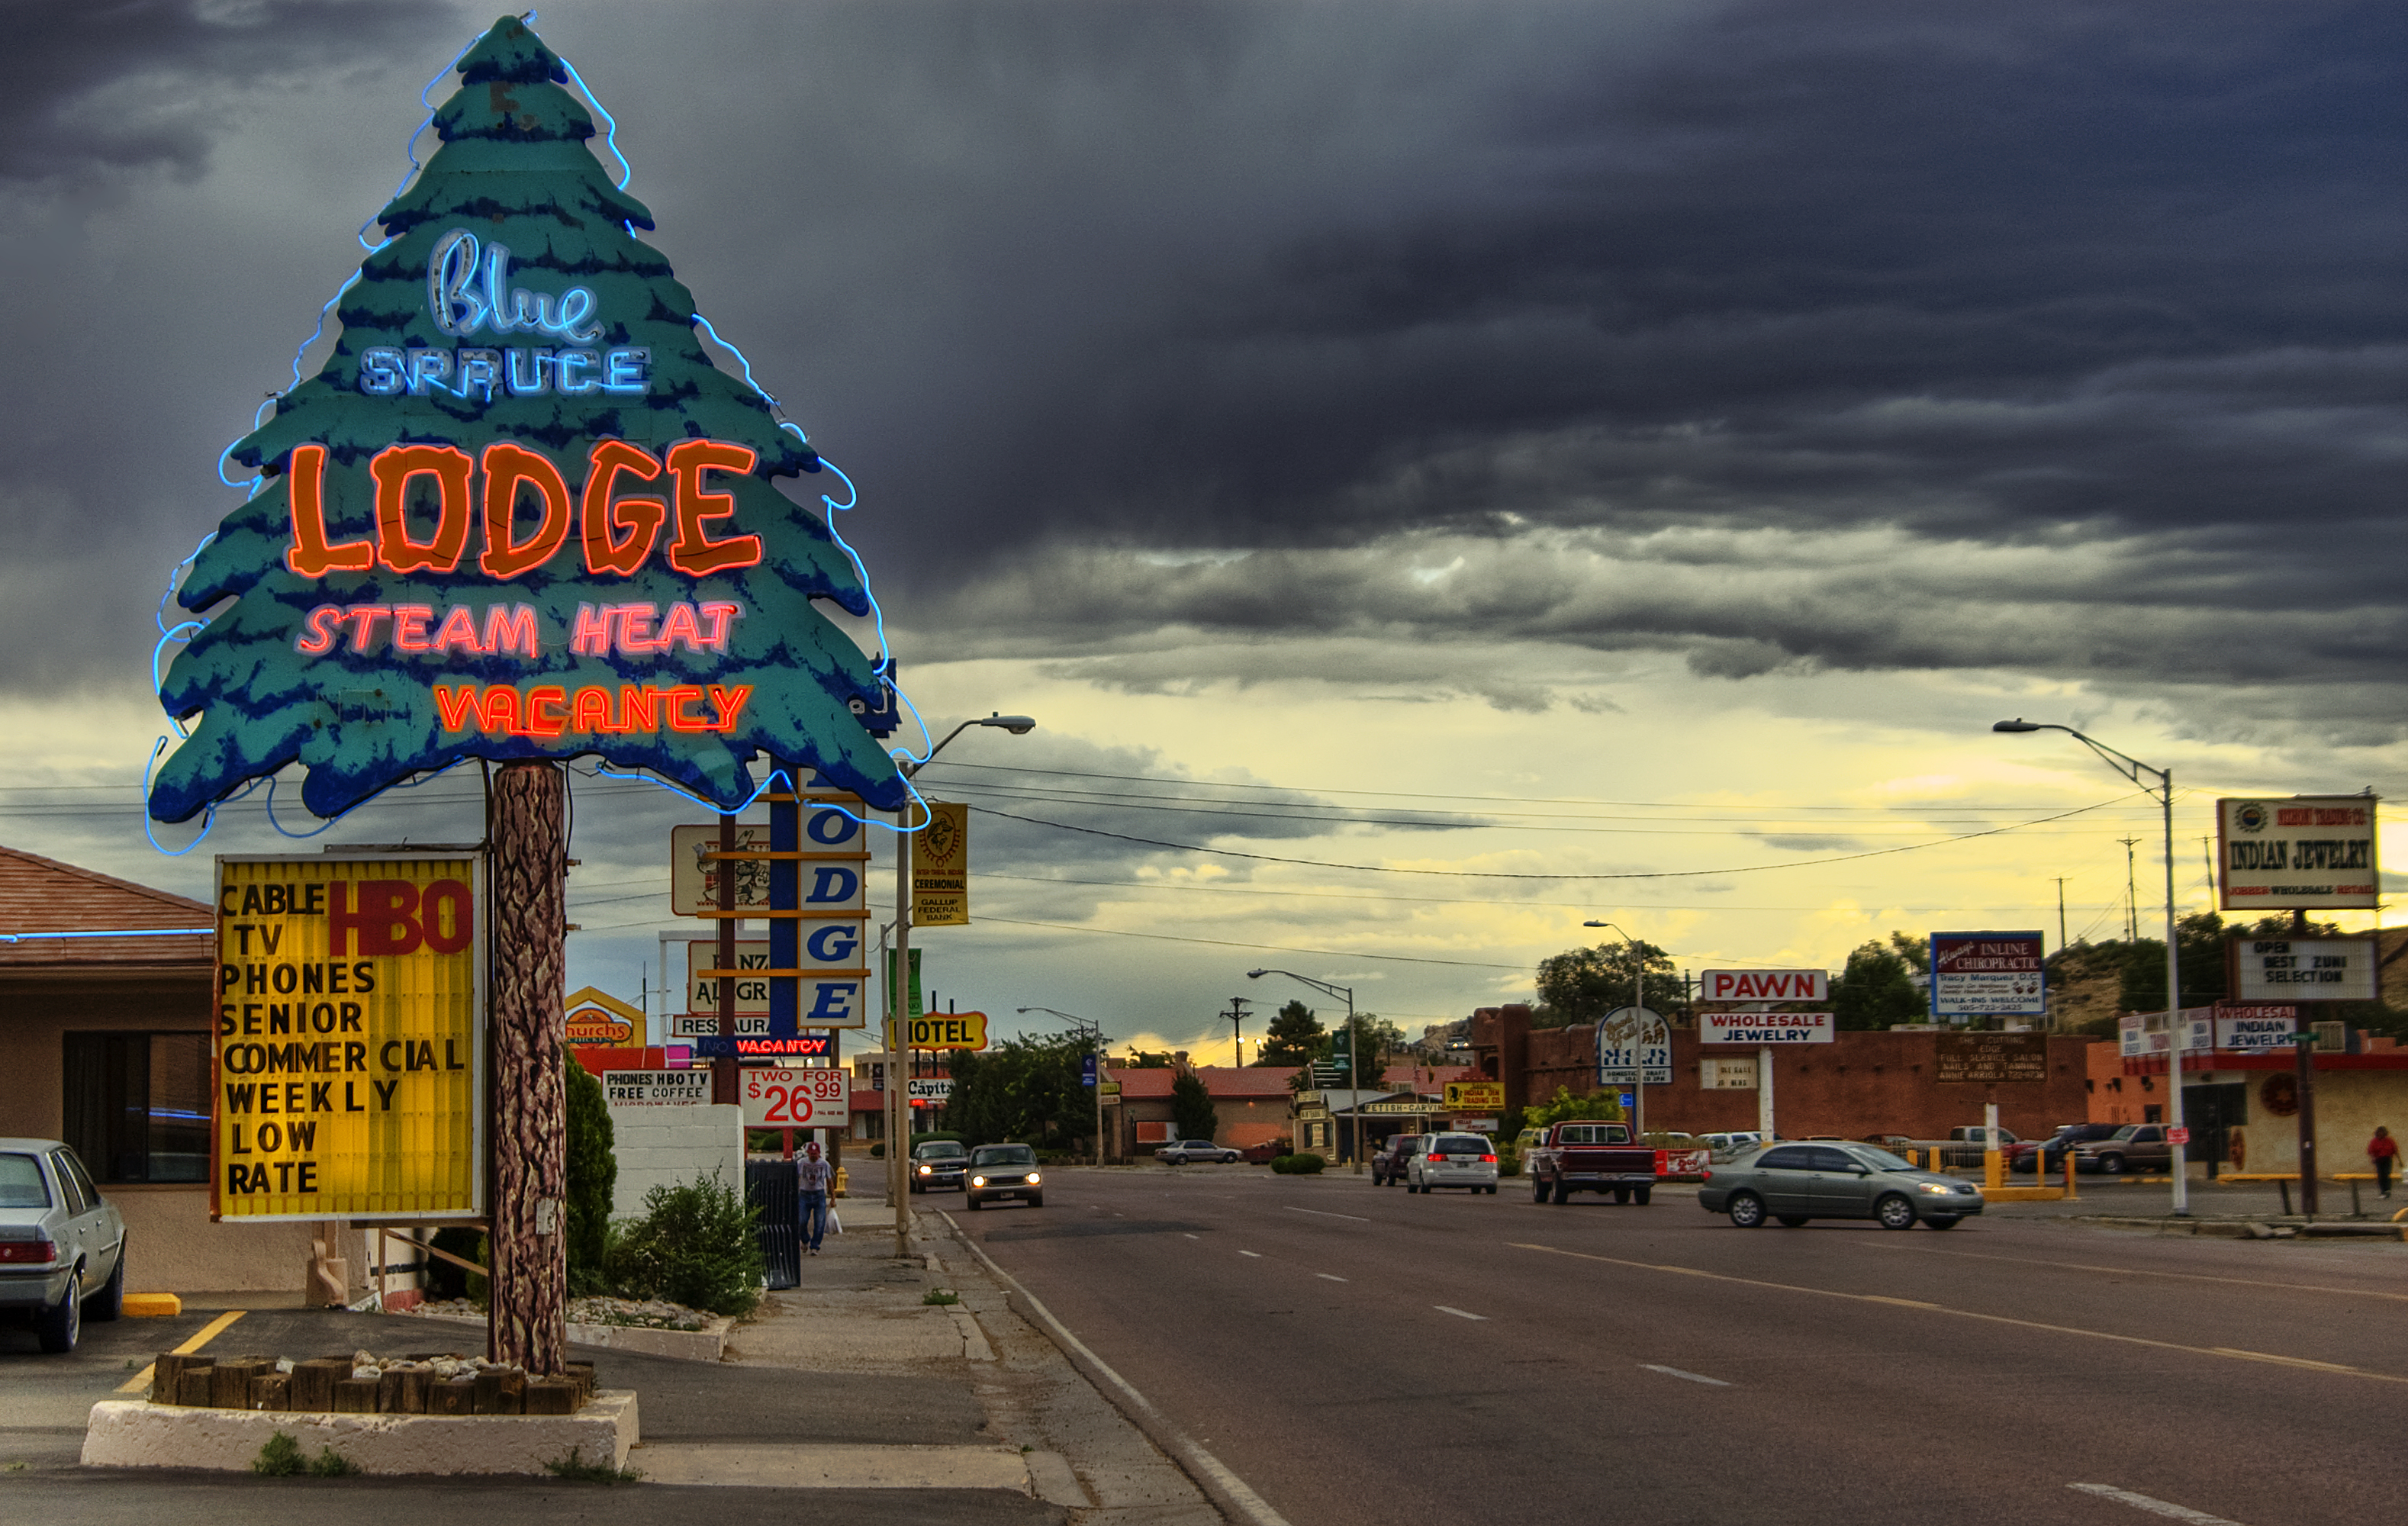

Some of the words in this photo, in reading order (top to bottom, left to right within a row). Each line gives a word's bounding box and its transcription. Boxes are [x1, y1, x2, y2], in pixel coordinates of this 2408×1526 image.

[429, 229, 605, 345] Blue
[360, 347, 651, 398] SPRUCE
[285, 439, 763, 578] LODGE
[295, 604, 542, 657] STEAM
[571, 602, 745, 655] HEAT
[433, 684, 754, 734] VACANCY
[2229, 840, 2287, 869] INDIAN
[2292, 840, 2369, 869] JEWELRY
[915, 879, 964, 890] CEREMONIAL
[222, 884, 324, 916] CABLE
[330, 879, 474, 957] HBO
[233, 924, 283, 955] TV
[1979, 942, 2029, 955] INLINE
[2253, 941, 2290, 954] OPEN
[1956, 957, 2039, 970] CHIROPRACTIC
[2264, 955, 2297, 968] BEST
[2313, 955, 2347, 968] ZUNI
[221, 961, 375, 995] PHONES
[1939, 974, 1965, 982] Tracy
[2265, 970, 2343, 983] SELECTION
[1716, 974, 1814, 998] PAWN
[221, 1002, 362, 1036] SENIOR
[2217, 1006, 2297, 1019] WHOLESAL
[1710, 1015, 1825, 1027] WHOLESALE
[2237, 1020, 2286, 1032] INDIAN
[1724, 1029, 1811, 1041] JEWELRY
[736, 1039, 826, 1053] VACANCY
[1979, 1045, 2002, 1053] EDGE
[607, 1074, 652, 1085] PHONES
[657, 1074, 685, 1085] HBO
[748, 1071, 793, 1082] TWO
[803, 1071, 842, 1082] FOR
[610, 1087, 643, 1099] FREE
[652, 1087, 703, 1098] COFFEE
[232, 1121, 317, 1155] LOW
[229, 1161, 318, 1195] RATE
